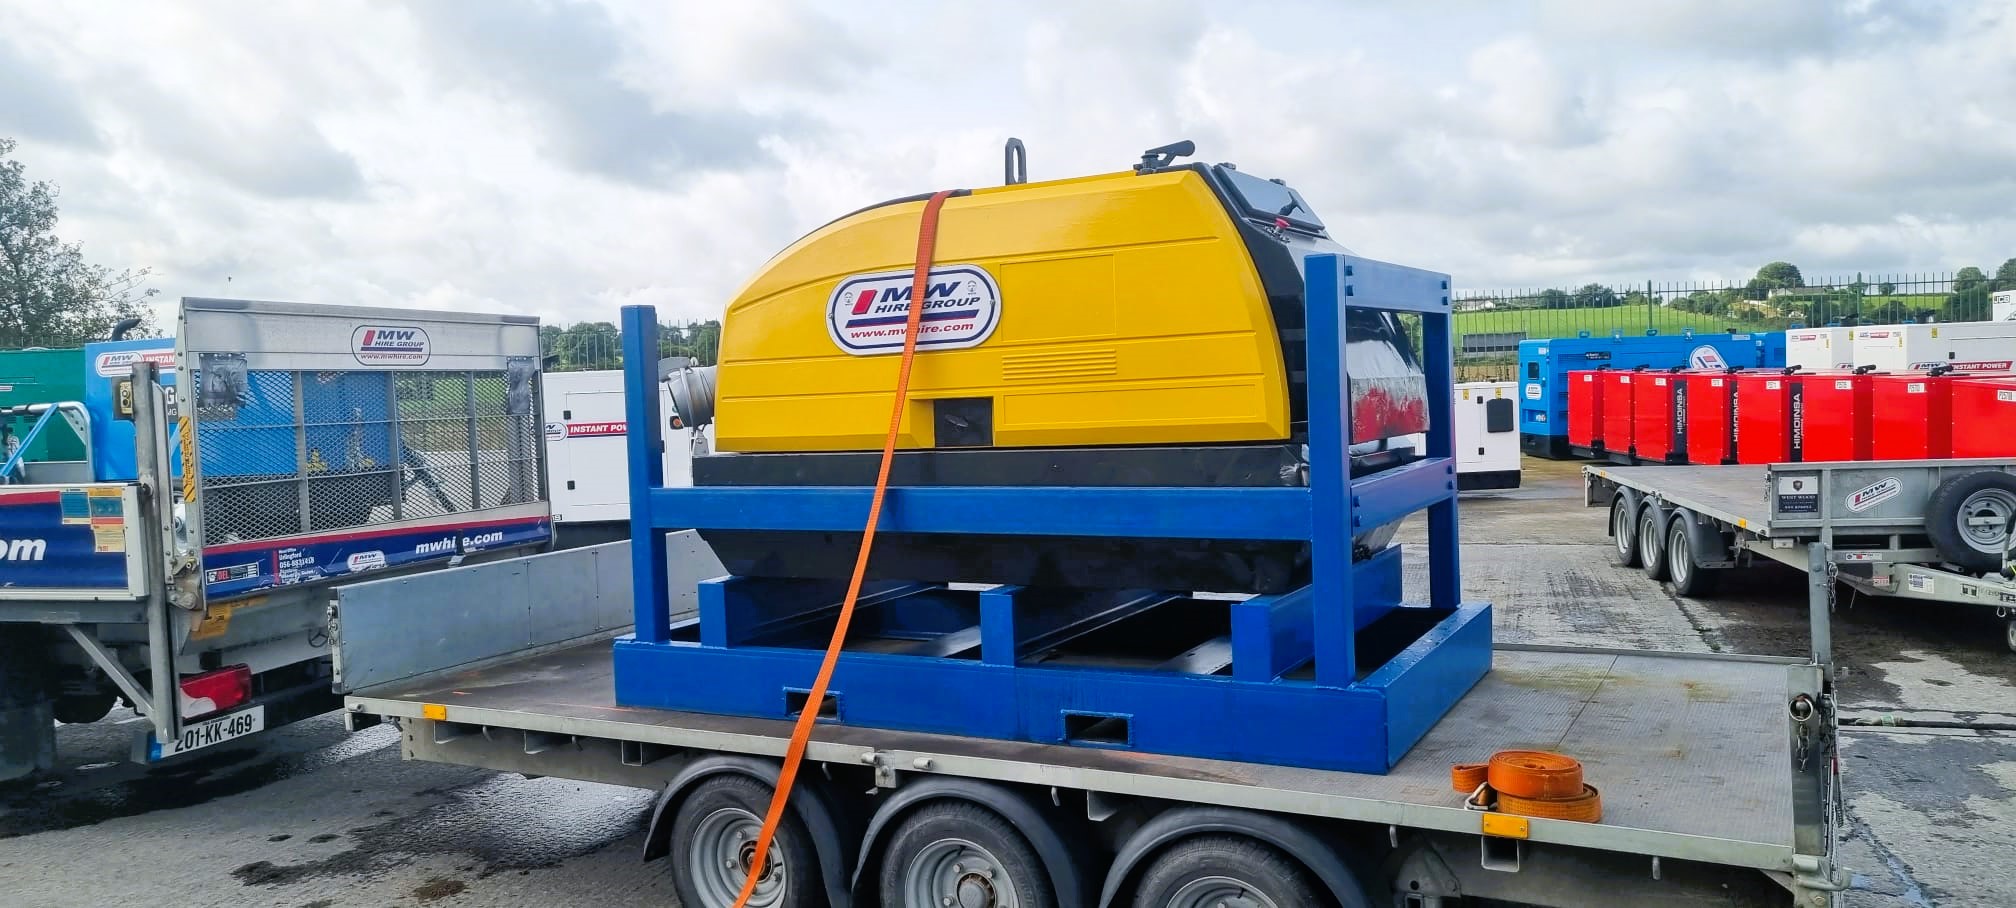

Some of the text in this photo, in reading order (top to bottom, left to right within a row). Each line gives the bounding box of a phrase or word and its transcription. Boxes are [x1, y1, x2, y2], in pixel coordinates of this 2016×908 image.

[880, 281, 961, 302] MW
[1993, 295, 2011, 304] JCB
[875, 297, 981, 314] HIRE GROUP
[377, 330, 415, 340] MW
[570, 425, 609, 433] INSTANT
[1793, 393, 1801, 449] HIMOINSA
[1862, 482, 1888, 497] MW
[415, 531, 503, 554] mwhie.com
[174, 713, 253, 753] 201-KK-469
